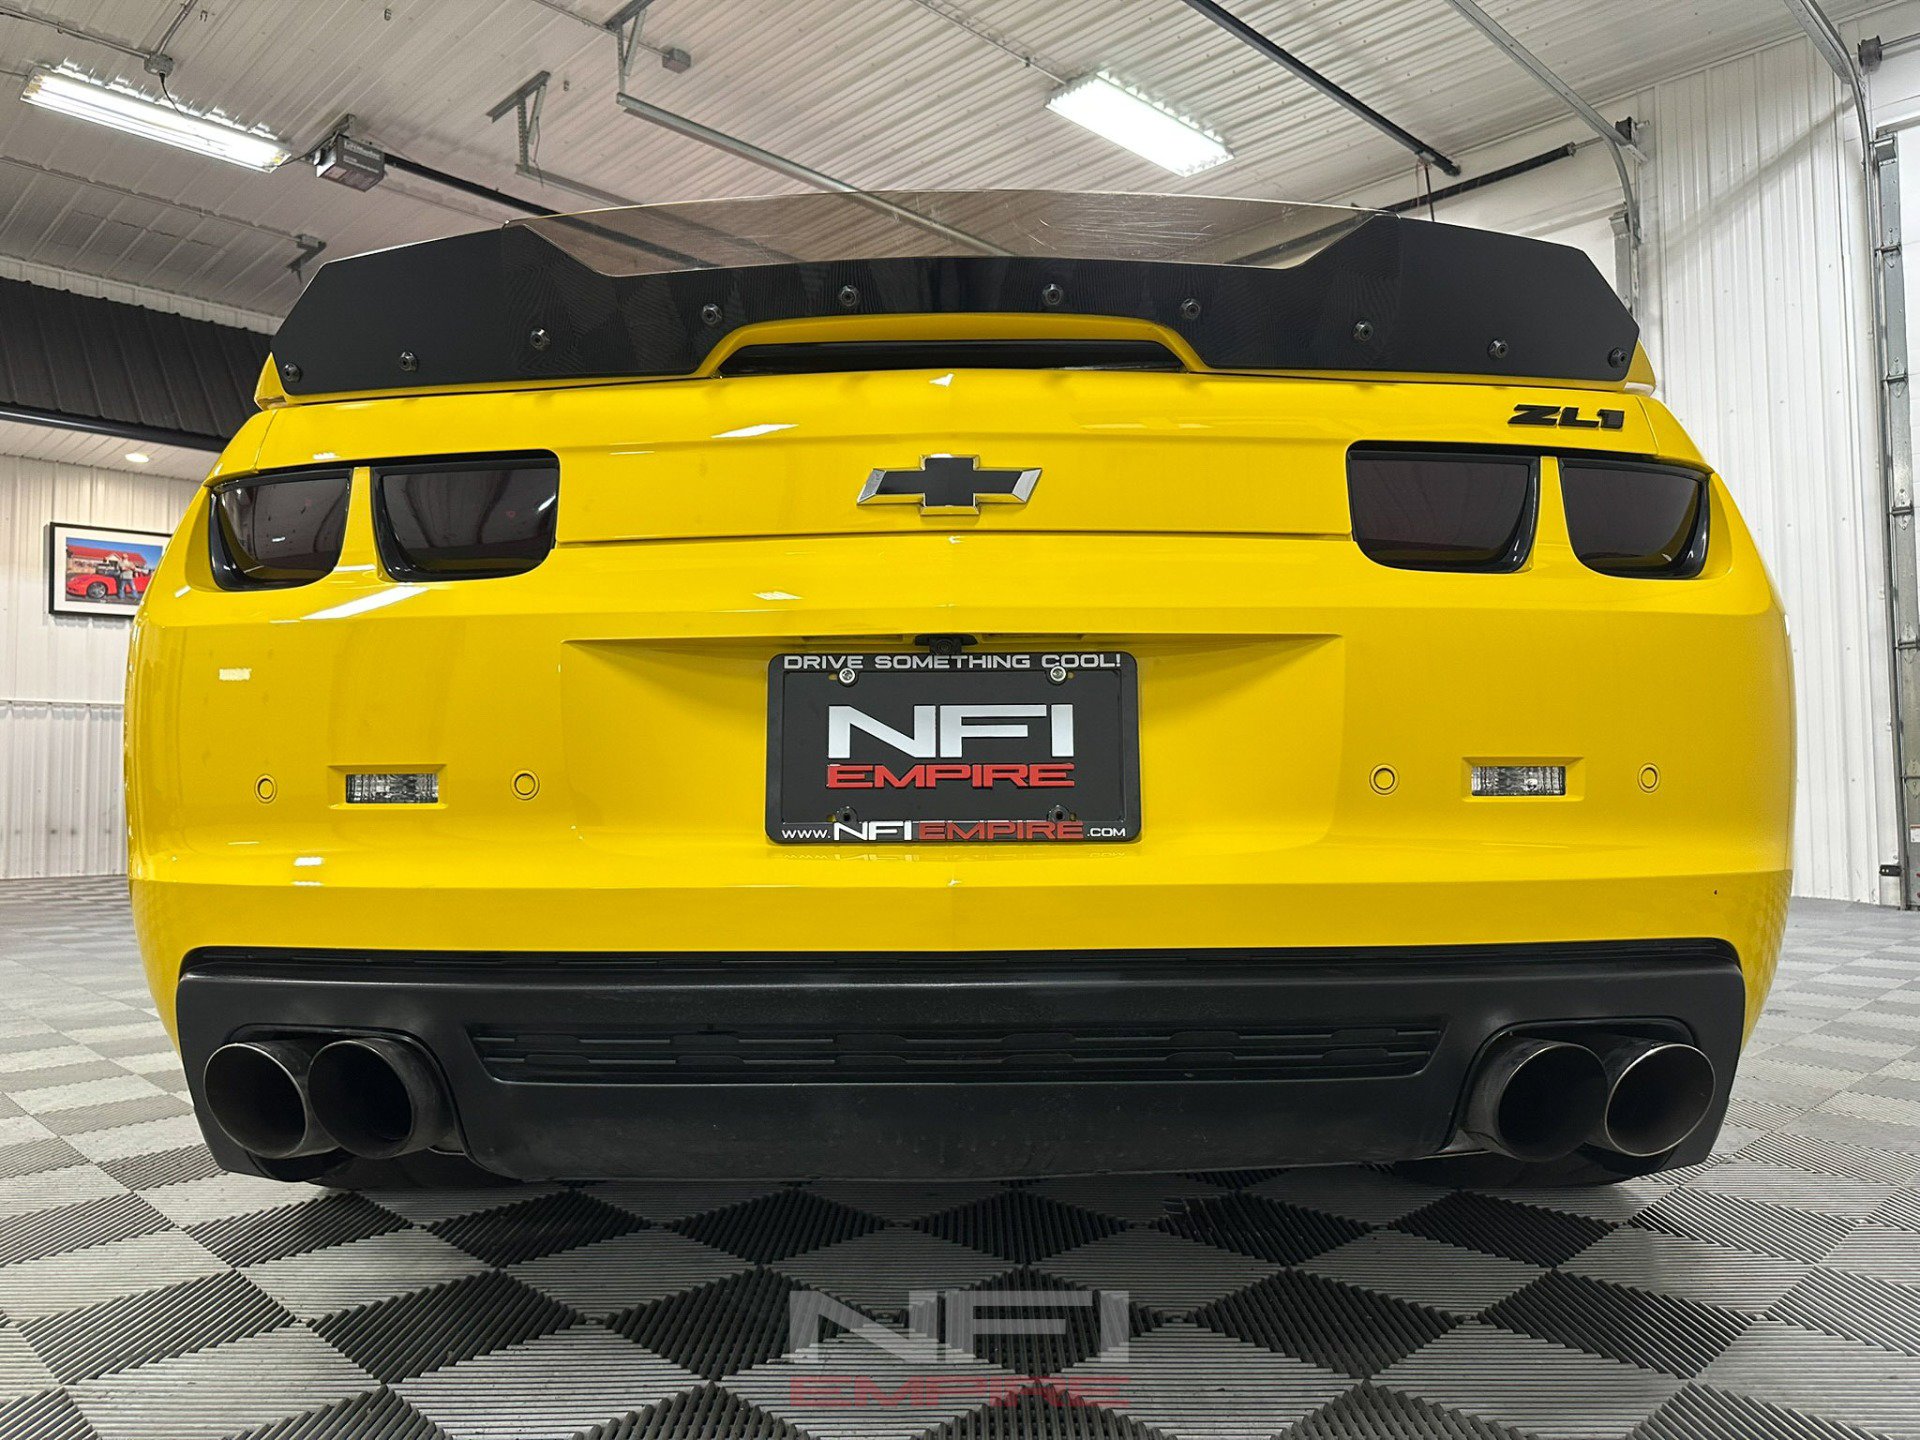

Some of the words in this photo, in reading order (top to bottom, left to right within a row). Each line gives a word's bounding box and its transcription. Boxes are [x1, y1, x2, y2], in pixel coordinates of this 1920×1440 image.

[1507, 404, 1625, 429] ZL1
[784, 655, 863, 669] DRIVE
[874, 655, 1031, 668] SOMETHING
[1041, 654, 1122, 668] COOL!
[828, 704, 1075, 758] NFI
[826, 763, 1076, 788] EMPIRE
